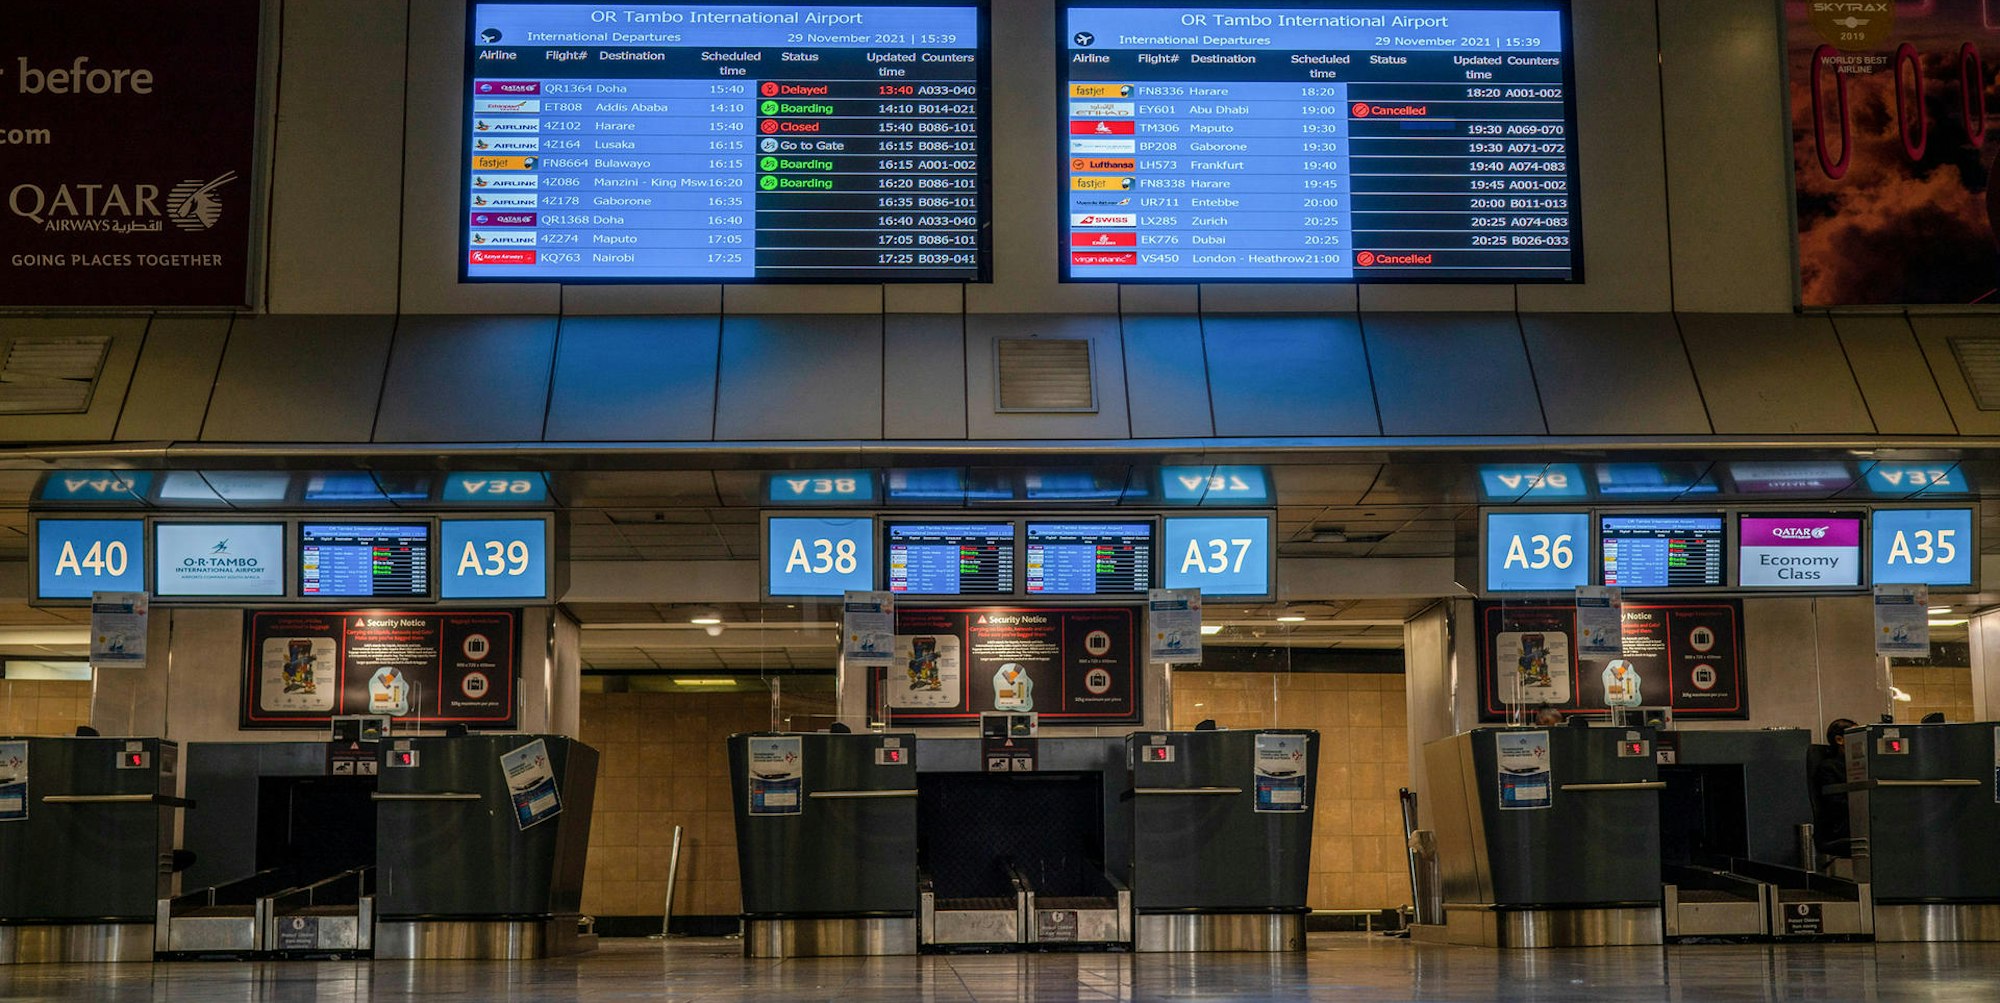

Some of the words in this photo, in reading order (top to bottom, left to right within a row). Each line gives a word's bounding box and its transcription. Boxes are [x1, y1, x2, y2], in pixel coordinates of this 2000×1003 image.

[1814, 2, 1888, 12] SKYTRAX
[591, 10, 617, 23] OR
[623, 10, 683, 23] Tambo
[690, 11, 799, 24] International
[806, 12, 863, 26] Airport
[1181, 14, 1207, 26] OR
[1213, 14, 1272, 27] Tambo
[1279, 15, 1386, 27] International
[1392, 16, 1448, 29] Airport
[528, 31, 608, 42] International
[612, 31, 681, 44] Departures
[788, 34, 803, 43] 29
[807, 34, 871, 43] November
[875, 34, 905, 44] 2021
[921, 34, 956, 44] 15:39
[1120, 35, 1199, 45] International
[1203, 35, 1270, 47] Departures
[1375, 36, 1391, 46] 29
[1395, 37, 1456, 47] November
[1461, 37, 1490, 47] 2021
[1506, 37, 1540, 47] 15:39
[480, 50, 516, 60] Airline
[546, 50, 587, 61] Flight#
[600, 51, 665, 60] Destination
[701, 51, 761, 61] Scheduled
[782, 52, 819, 61] Status
[867, 53, 916, 63] Updated
[922, 53, 974, 62] Counters
[1073, 54, 1109, 63] Airline
[1138, 54, 1179, 64] Flight#
[1191, 54, 1256, 63] Destination
[1291, 54, 1350, 64] Scheduled
[1370, 55, 1407, 64] Status
[1454, 56, 1502, 66] Updated
[1507, 53, 1560, 66] Counters
[18, 56, 153, 94] before
[720, 66, 746, 76] time
[879, 67, 905, 77] time
[545, 83, 592, 94] QR1364
[596, 83, 627, 94] Doha
[711, 84, 745, 94] 15:40
[781, 84, 827, 97] Delayed
[880, 85, 913, 95] 13:40
[918, 85, 975, 95] A033-040
[1139, 86, 1184, 96] FN8336
[1190, 87, 1228, 96] Harare
[1302, 87, 1335, 97] 18:20
[1505, 89, 1562, 98] A001-002
[545, 102, 582, 111] ET808
[596, 103, 630, 111] Addis
[634, 103, 668, 112] Ababa
[710, 103, 744, 112] 14:10
[780, 104, 834, 116] Boarding
[919, 104, 975, 113] B014-021
[1139, 104, 1175, 114] EY601
[1189, 105, 1209, 114] Abu
[1214, 105, 1249, 114] Dhabi
[1303, 105, 1336, 114] 19:00
[1371, 105, 1426, 116] Cancelled
[543, 121, 581, 130] 4Z102
[595, 122, 635, 130] Harare
[780, 121, 820, 132] Closed
[919, 123, 975, 132] B086-101
[1139, 123, 1180, 132] TM306
[1190, 124, 1233, 136] Maputo
[1303, 124, 1336, 133] 19:30
[1507, 125, 1563, 134] A069-070
[543, 139, 580, 149] 4Z164
[595, 140, 634, 149] Lusaka
[710, 141, 744, 150] 16:15
[780, 141, 797, 150] Go
[800, 141, 811, 150] to
[816, 141, 844, 151] Gate
[1140, 141, 1176, 151] BP208
[1190, 141, 1247, 152] Gaborone
[543, 158, 588, 168] FN8664
[595, 158, 650, 172] Bulawayo
[780, 159, 833, 172] Boarding
[918, 160, 975, 170] A001-002
[1140, 160, 1176, 170] LH573
[1191, 160, 1244, 170] Frankfurt
[1304, 161, 1337, 171] 19:40
[1508, 161, 1565, 172] A074-083
[543, 177, 580, 186] 4Z086
[594, 178, 638, 186] Manzini
[651, 178, 677, 190] King
[708, 178, 743, 187] 16:20
[1140, 179, 1185, 188] FN8338
[1191, 180, 1230, 188] Harare
[1305, 179, 1337, 188] 19:45
[9, 184, 162, 224] QATAR
[542, 196, 579, 205] 4Z178
[593, 197, 651, 206] Gaborone
[709, 197, 743, 206] 16:35
[1141, 198, 1178, 207] UR711
[1192, 198, 1239, 207] Entebbe
[1304, 198, 1338, 208] 20:00
[1510, 199, 1567, 208] B011-013
[45, 219, 110, 231] AIRWAYS
[542, 215, 589, 226] QR1368
[593, 216, 624, 225] Doha
[709, 216, 743, 225] 16:40
[1141, 217, 1177, 226] LX285
[1192, 217, 1228, 226] Zurich
[1304, 216, 1338, 226] 20:25
[541, 233, 578, 244] 4Z274
[593, 234, 638, 247] Maputo
[709, 234, 742, 244] 17:05
[1141, 235, 1178, 245] EK776
[1192, 235, 1226, 245] Dubai
[12, 254, 66, 266] GOING
[72, 254, 132, 266] PLACES
[138, 254, 222, 266] TOGETHER
[541, 253, 581, 264] KQ763
[593, 253, 634, 262] Nairobi
[708, 253, 742, 262] 17:25
[1141, 254, 1179, 263] VS450
[1193, 254, 1234, 263] London
[1248, 254, 1305, 263] Heathrow
[1376, 253, 1432, 264] Cancelled
[1772, 528, 1811, 536] QATAR
[1504, 535, 1573, 569] A36
[1888, 530, 1956, 564] A35
[55, 540, 128, 576] A40
[457, 540, 529, 576] A39
[786, 539, 857, 574] A38
[1180, 539, 1252, 574] A37
[1760, 554, 1839, 568] Economy
[1778, 568, 1820, 580] Class
[367, 618, 398, 628] Security
[989, 616, 1020, 625] Security
